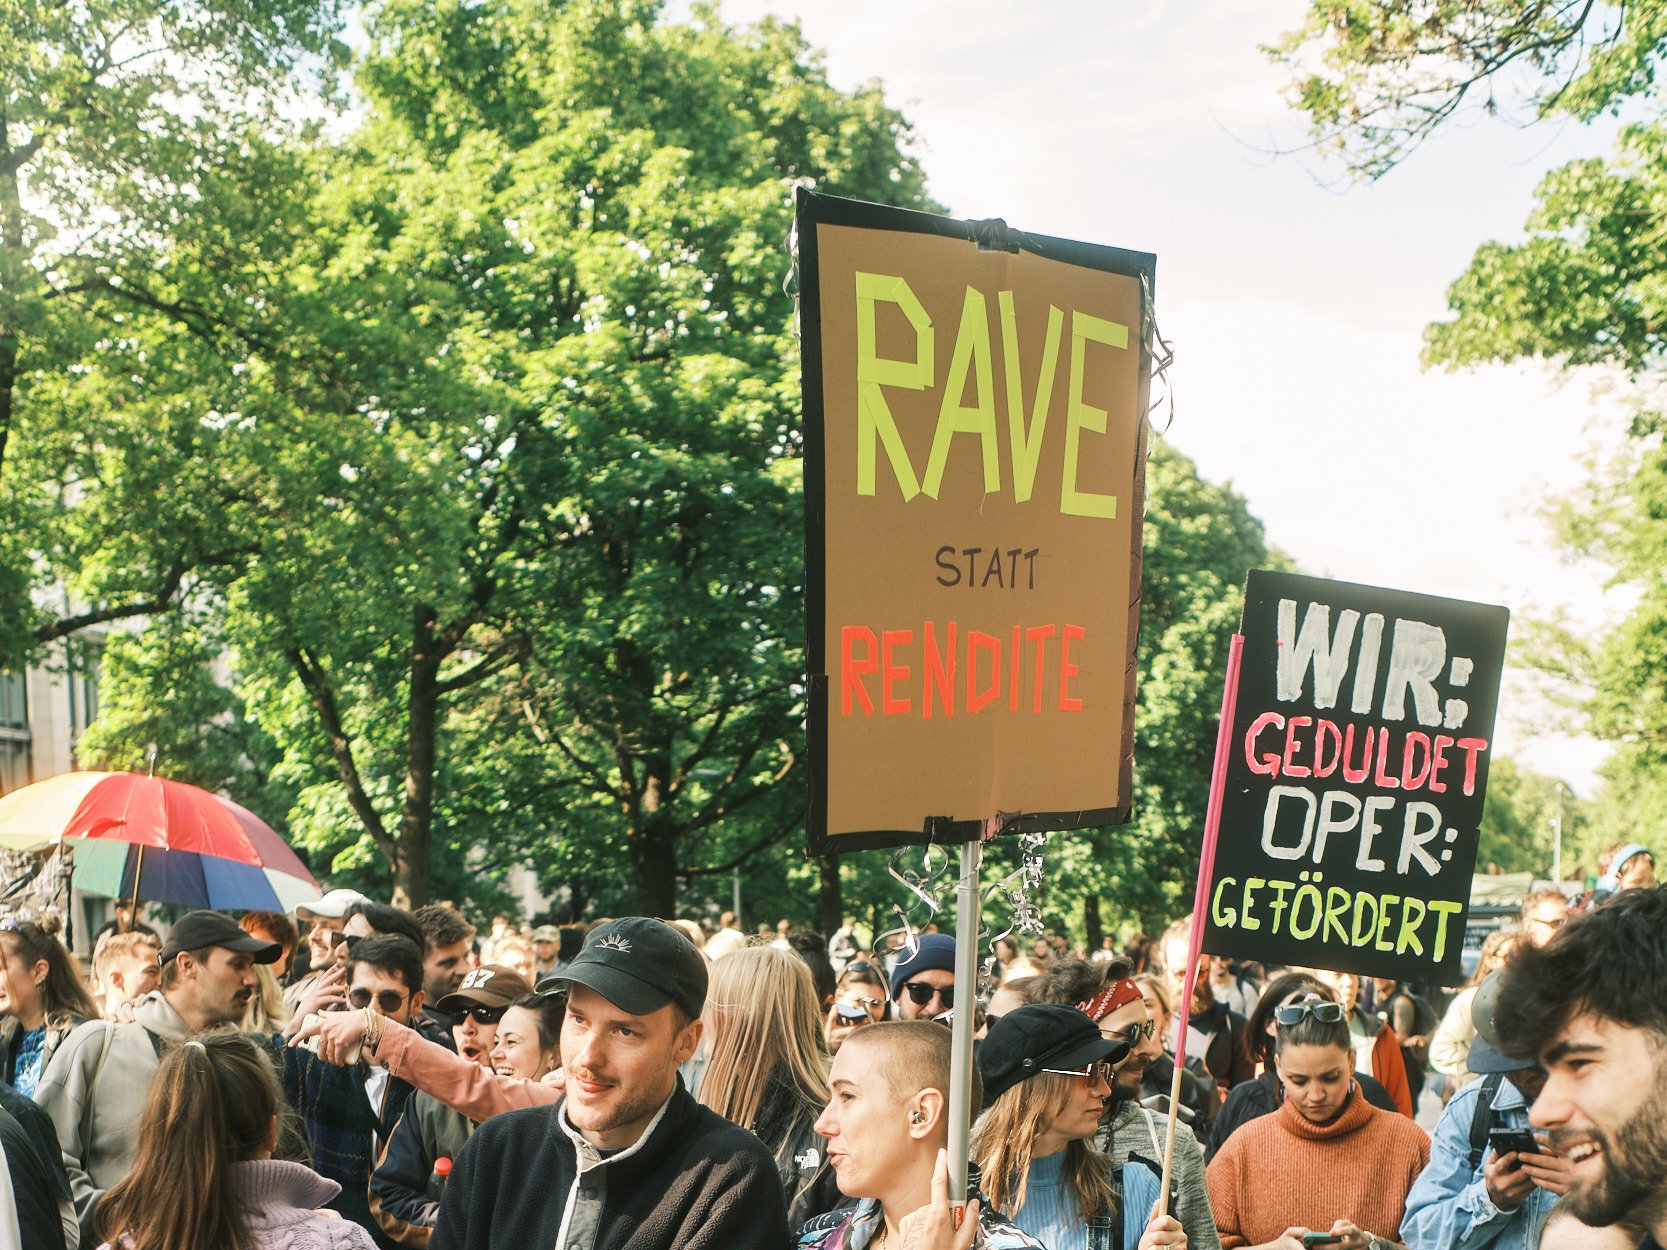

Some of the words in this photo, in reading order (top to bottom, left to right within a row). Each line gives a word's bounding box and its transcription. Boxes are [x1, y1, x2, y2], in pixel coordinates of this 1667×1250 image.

[855, 271, 1130, 520] RAVE
[935, 546, 1040, 590] STATT
[841, 621, 1086, 719] RENDITE
[1276, 598, 1474, 729] WIR:
[1245, 712, 1488, 797] GEDULDET
[1261, 785, 1459, 876] OPER:
[1212, 871, 1463, 962] GEFÖRDERT
